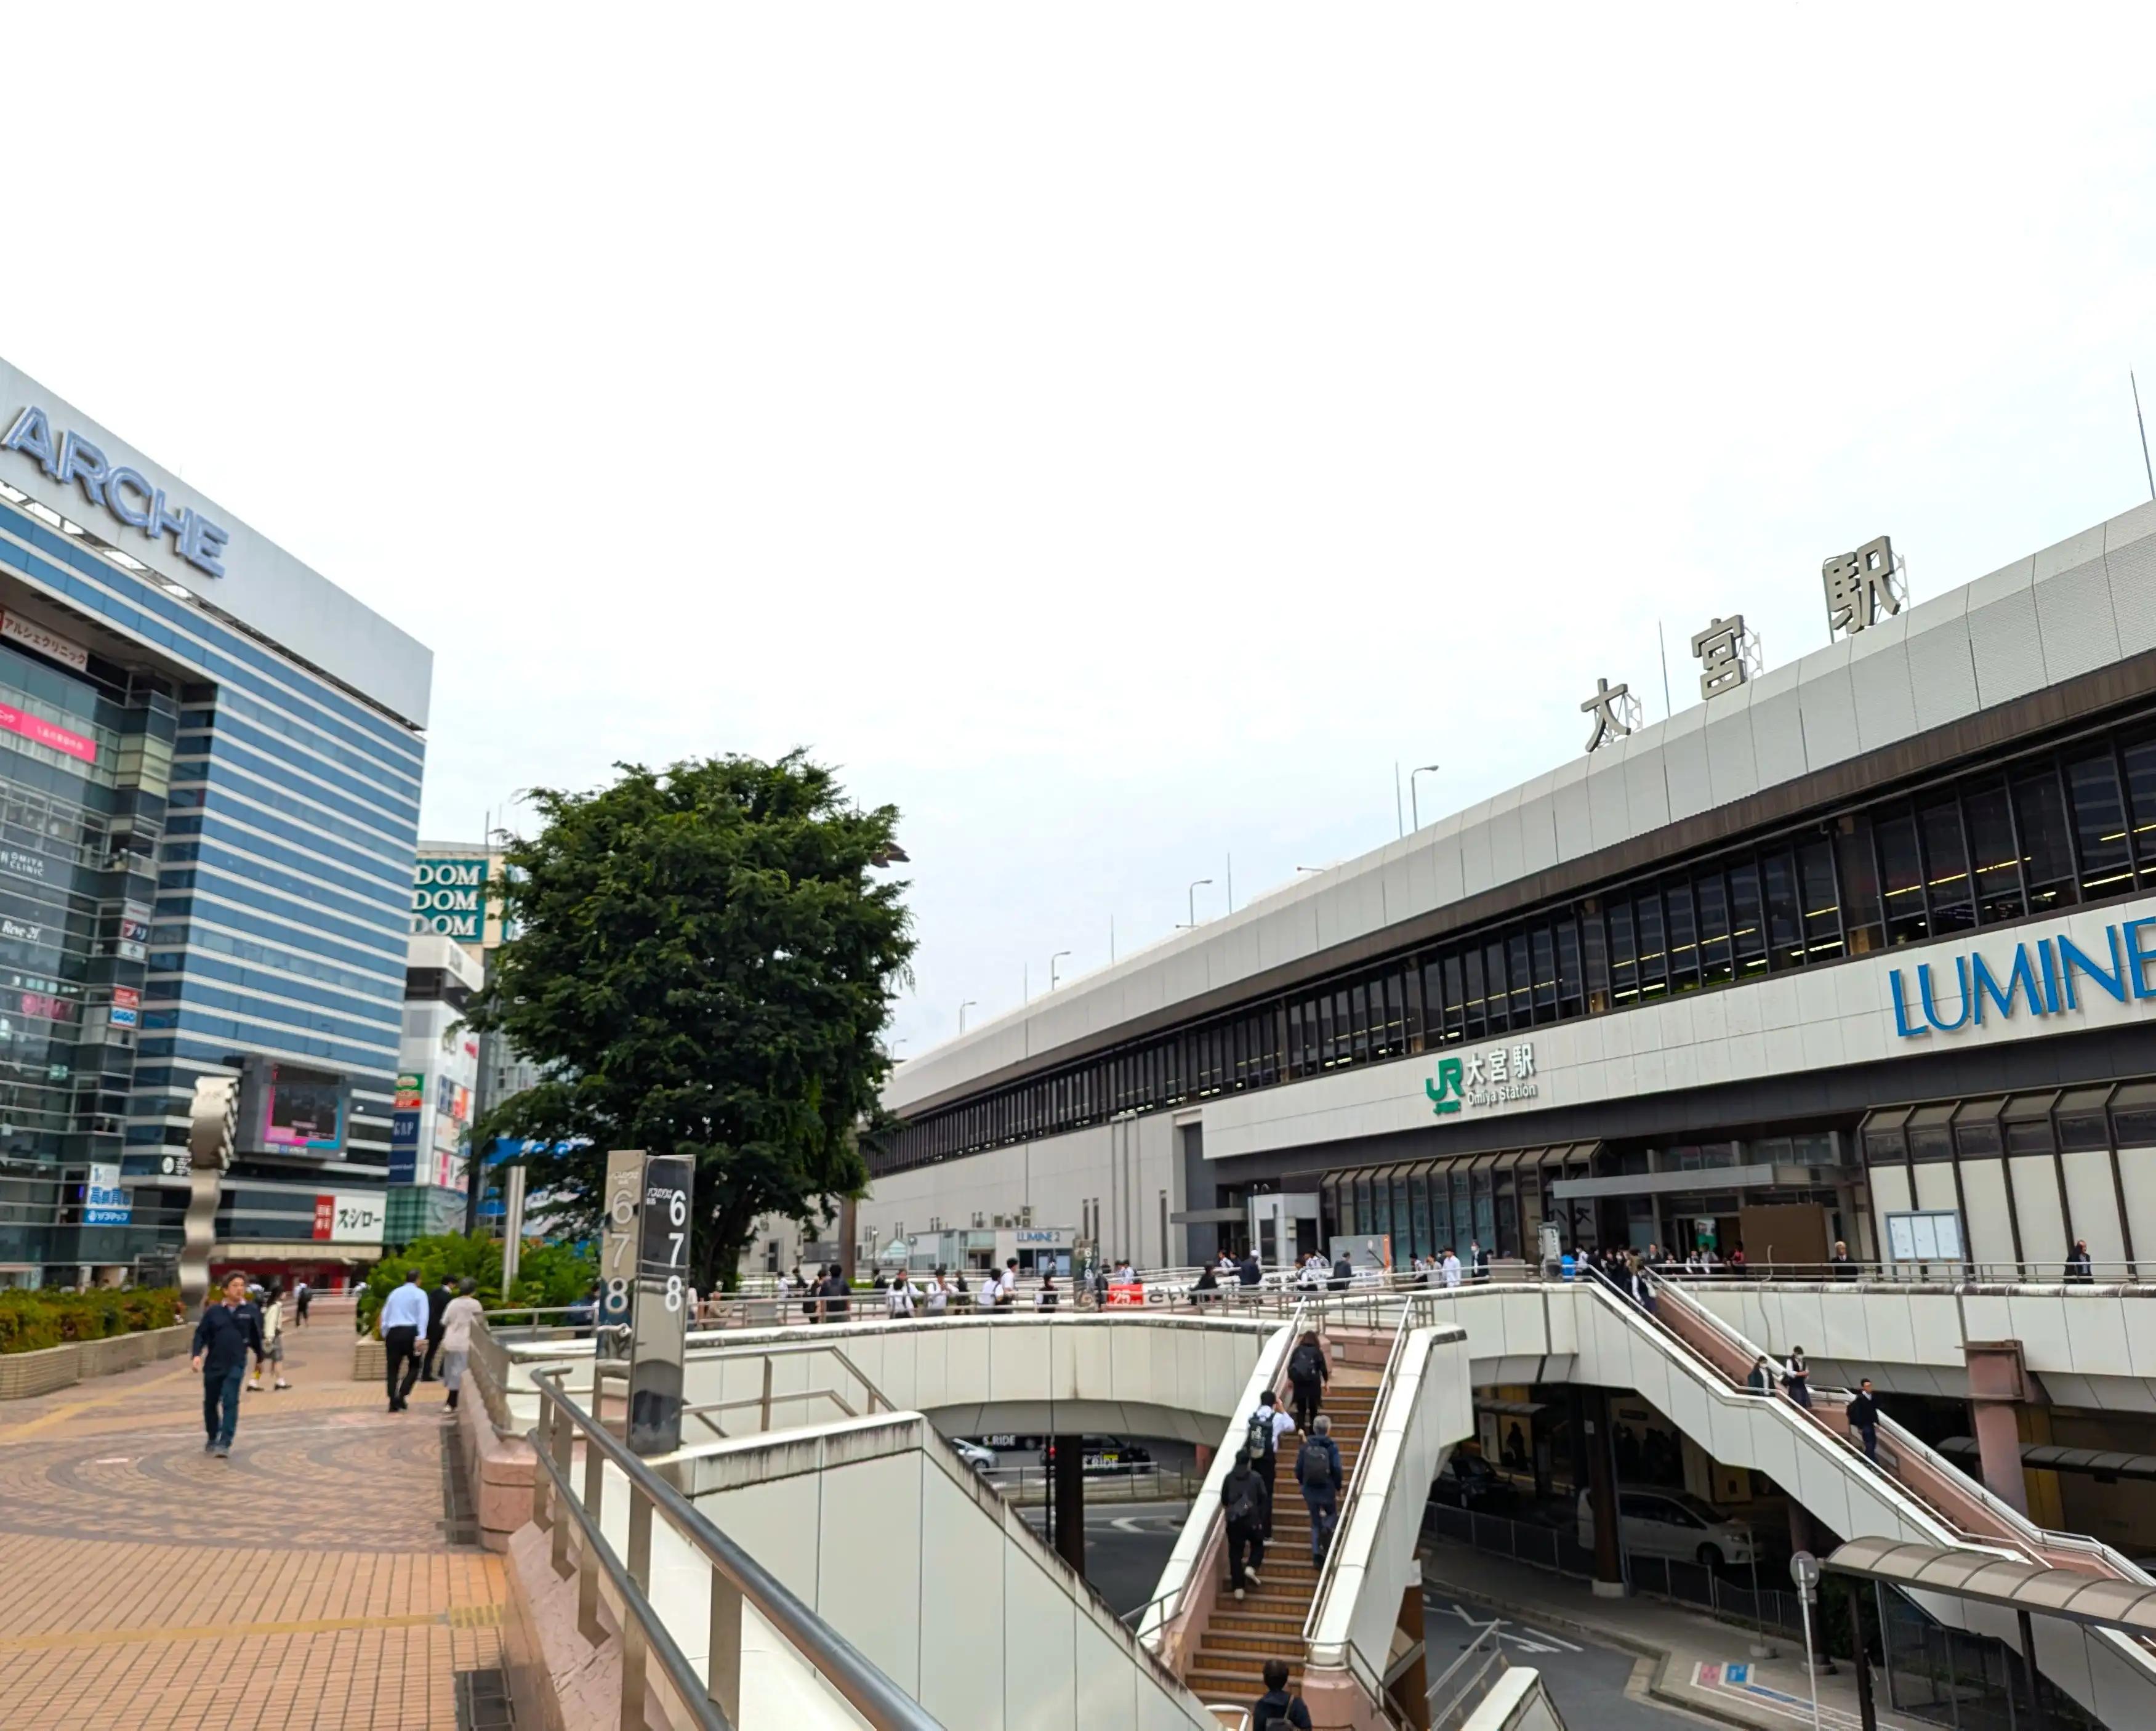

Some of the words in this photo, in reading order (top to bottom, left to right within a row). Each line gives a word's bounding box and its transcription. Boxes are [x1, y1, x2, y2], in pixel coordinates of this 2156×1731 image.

[2, 405, 230, 579] ARCHE
[1580, 535, 1901, 753] 大宮駅
[414, 864, 482, 886] DOM
[411, 889, 479, 911] DOM
[410, 913, 478, 936] DOM
[1889, 916, 2156, 1037] LUMINE
[1425, 1057, 1465, 1101] JR
[1466, 1043, 1537, 1087] 大宮駅
[1467, 1089, 1498, 1106] Omiya
[1499, 1083, 1537, 1102] Station
[337, 1208, 382, 1229] スシロー
[612, 1188, 634, 1225] 6
[670, 1190, 687, 1227] 6
[610, 1232, 630, 1269] 7
[668, 1232, 685, 1269] 7
[605, 1277, 629, 1313] 8
[665, 1275, 683, 1313] 8
